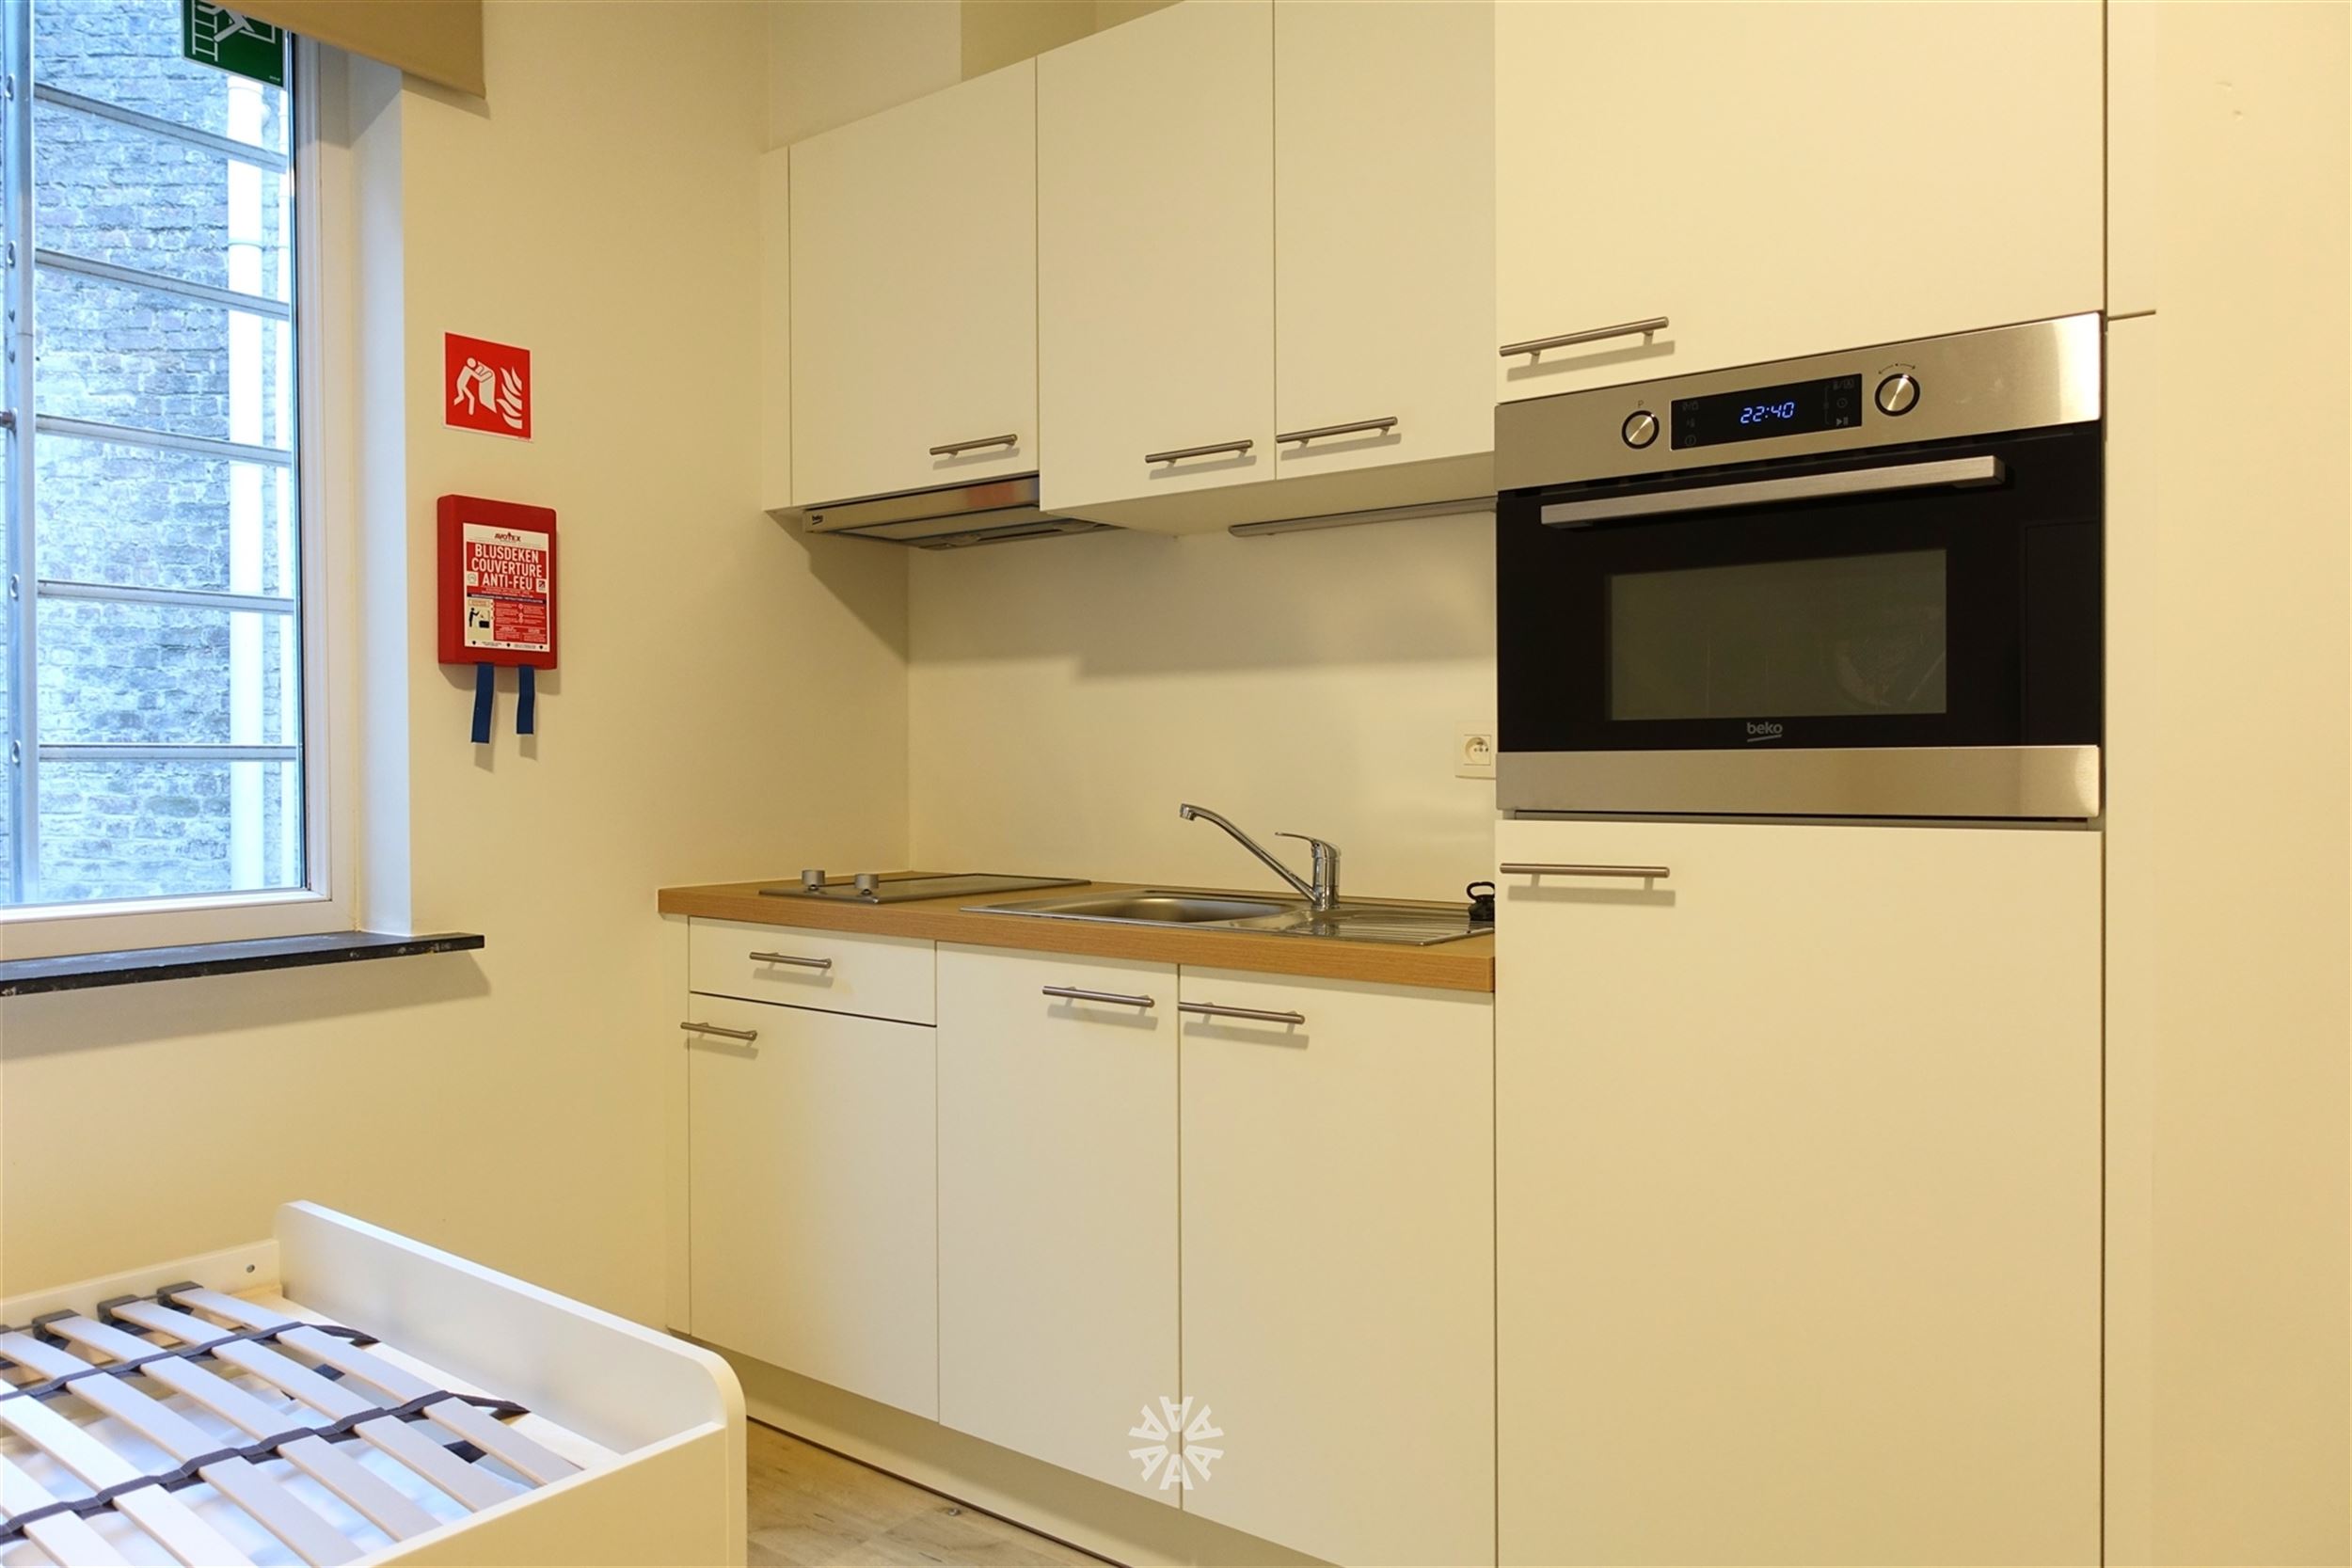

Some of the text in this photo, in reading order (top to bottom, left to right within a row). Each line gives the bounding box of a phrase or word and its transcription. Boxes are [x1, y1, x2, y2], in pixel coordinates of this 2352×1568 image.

[1740, 402, 1794, 424] 22:40
[474, 544, 539, 563] BLUSDEKEN
[471, 558, 542, 578] COUVERTURE
[482, 573, 533, 590] ANTI-FEU
[1747, 721, 1783, 735] beko
